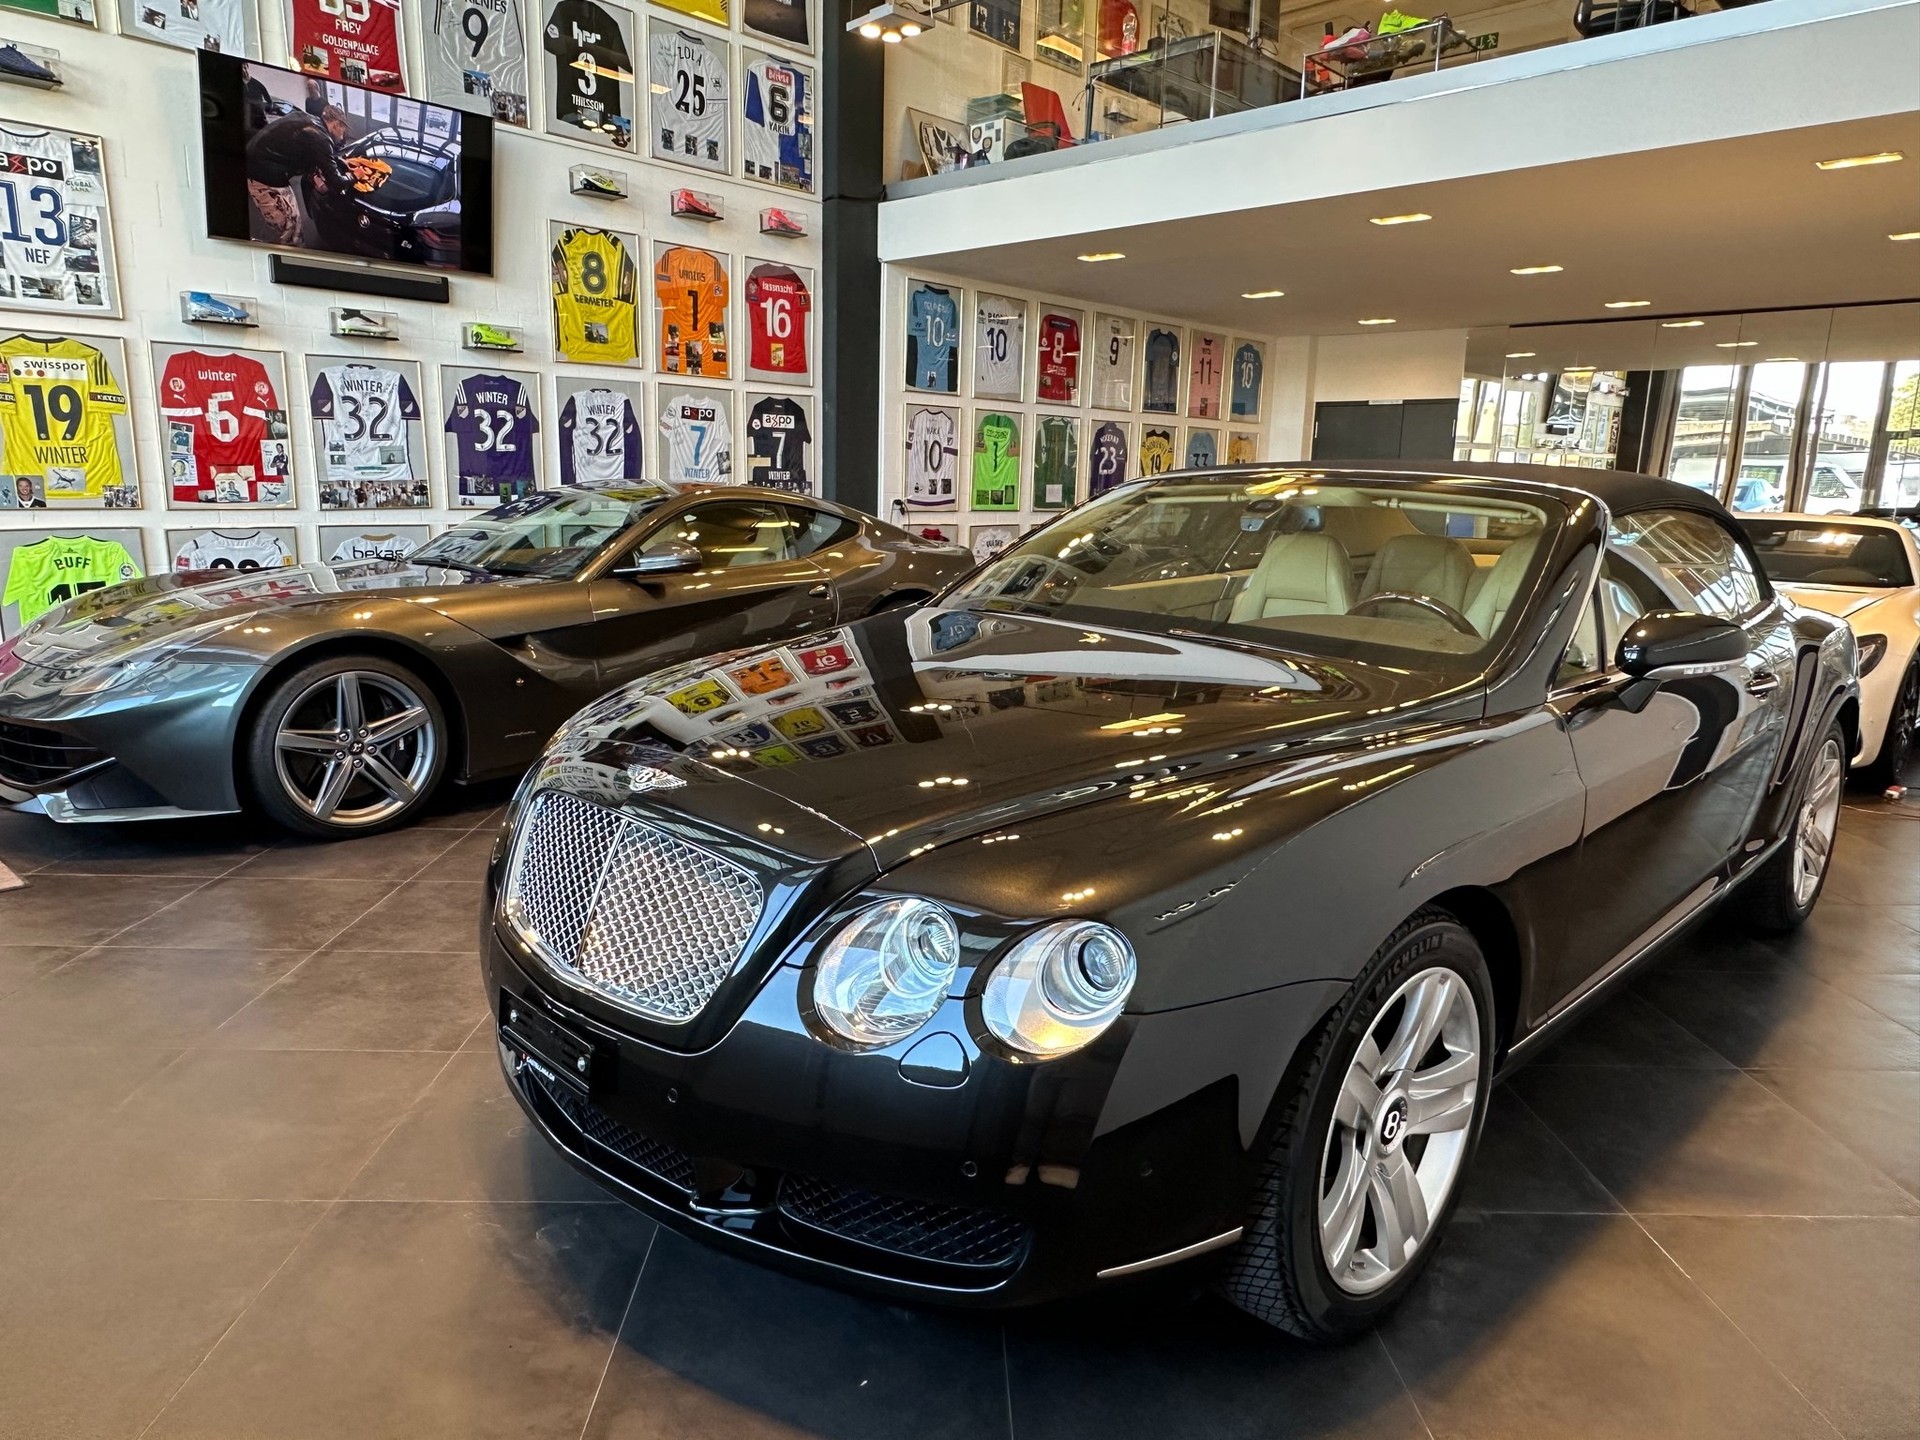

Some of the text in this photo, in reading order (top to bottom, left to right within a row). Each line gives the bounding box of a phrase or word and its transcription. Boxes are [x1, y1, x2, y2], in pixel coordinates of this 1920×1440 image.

[335, 19, 361, 35] FREY
[462, 8, 489, 57] 9
[322, 33, 379, 56] GOLDENPALACE
[677, 47, 703, 67] ZOLA
[577, 52, 597, 96] 3
[675, 70, 706, 117] 25
[768, 84, 789, 124] 6
[768, 121, 790, 135] YAKIN
[0, 180, 68, 246] 13
[25, 247, 51, 264] NEF
[581, 251, 608, 295] 8
[687, 290, 698, 331] 1
[761, 297, 792, 338] 16
[925, 315, 945, 347] 10
[987, 327, 1007, 361] 10
[1053, 332, 1064, 364] 8
[1109, 337, 1119, 365] 9
[24, 359, 85, 372] swisspor
[198, 371, 237, 381] winter
[1200, 358, 1211, 384] 11
[1241, 362, 1254, 389] 10
[343, 379, 383, 393] WINTER
[475, 391, 509, 405] WINTER
[23, 384, 83, 441] 19
[341, 395, 393, 441] 32
[587, 404, 616, 416] WINTER
[473, 409, 517, 452] 32
[585, 417, 623, 456] 32
[689, 425, 706, 467] 7
[34, 446, 88, 464] WINTER
[772, 432, 786, 469] 7
[924, 440, 942, 473] 10
[1099, 446, 1117, 475] 23
[684, 467, 710, 480] WINTER
[768, 470, 791, 480] WINTER
[54, 556, 91, 570] BUFF
[1375, 934, 1441, 999] MICHELIN
